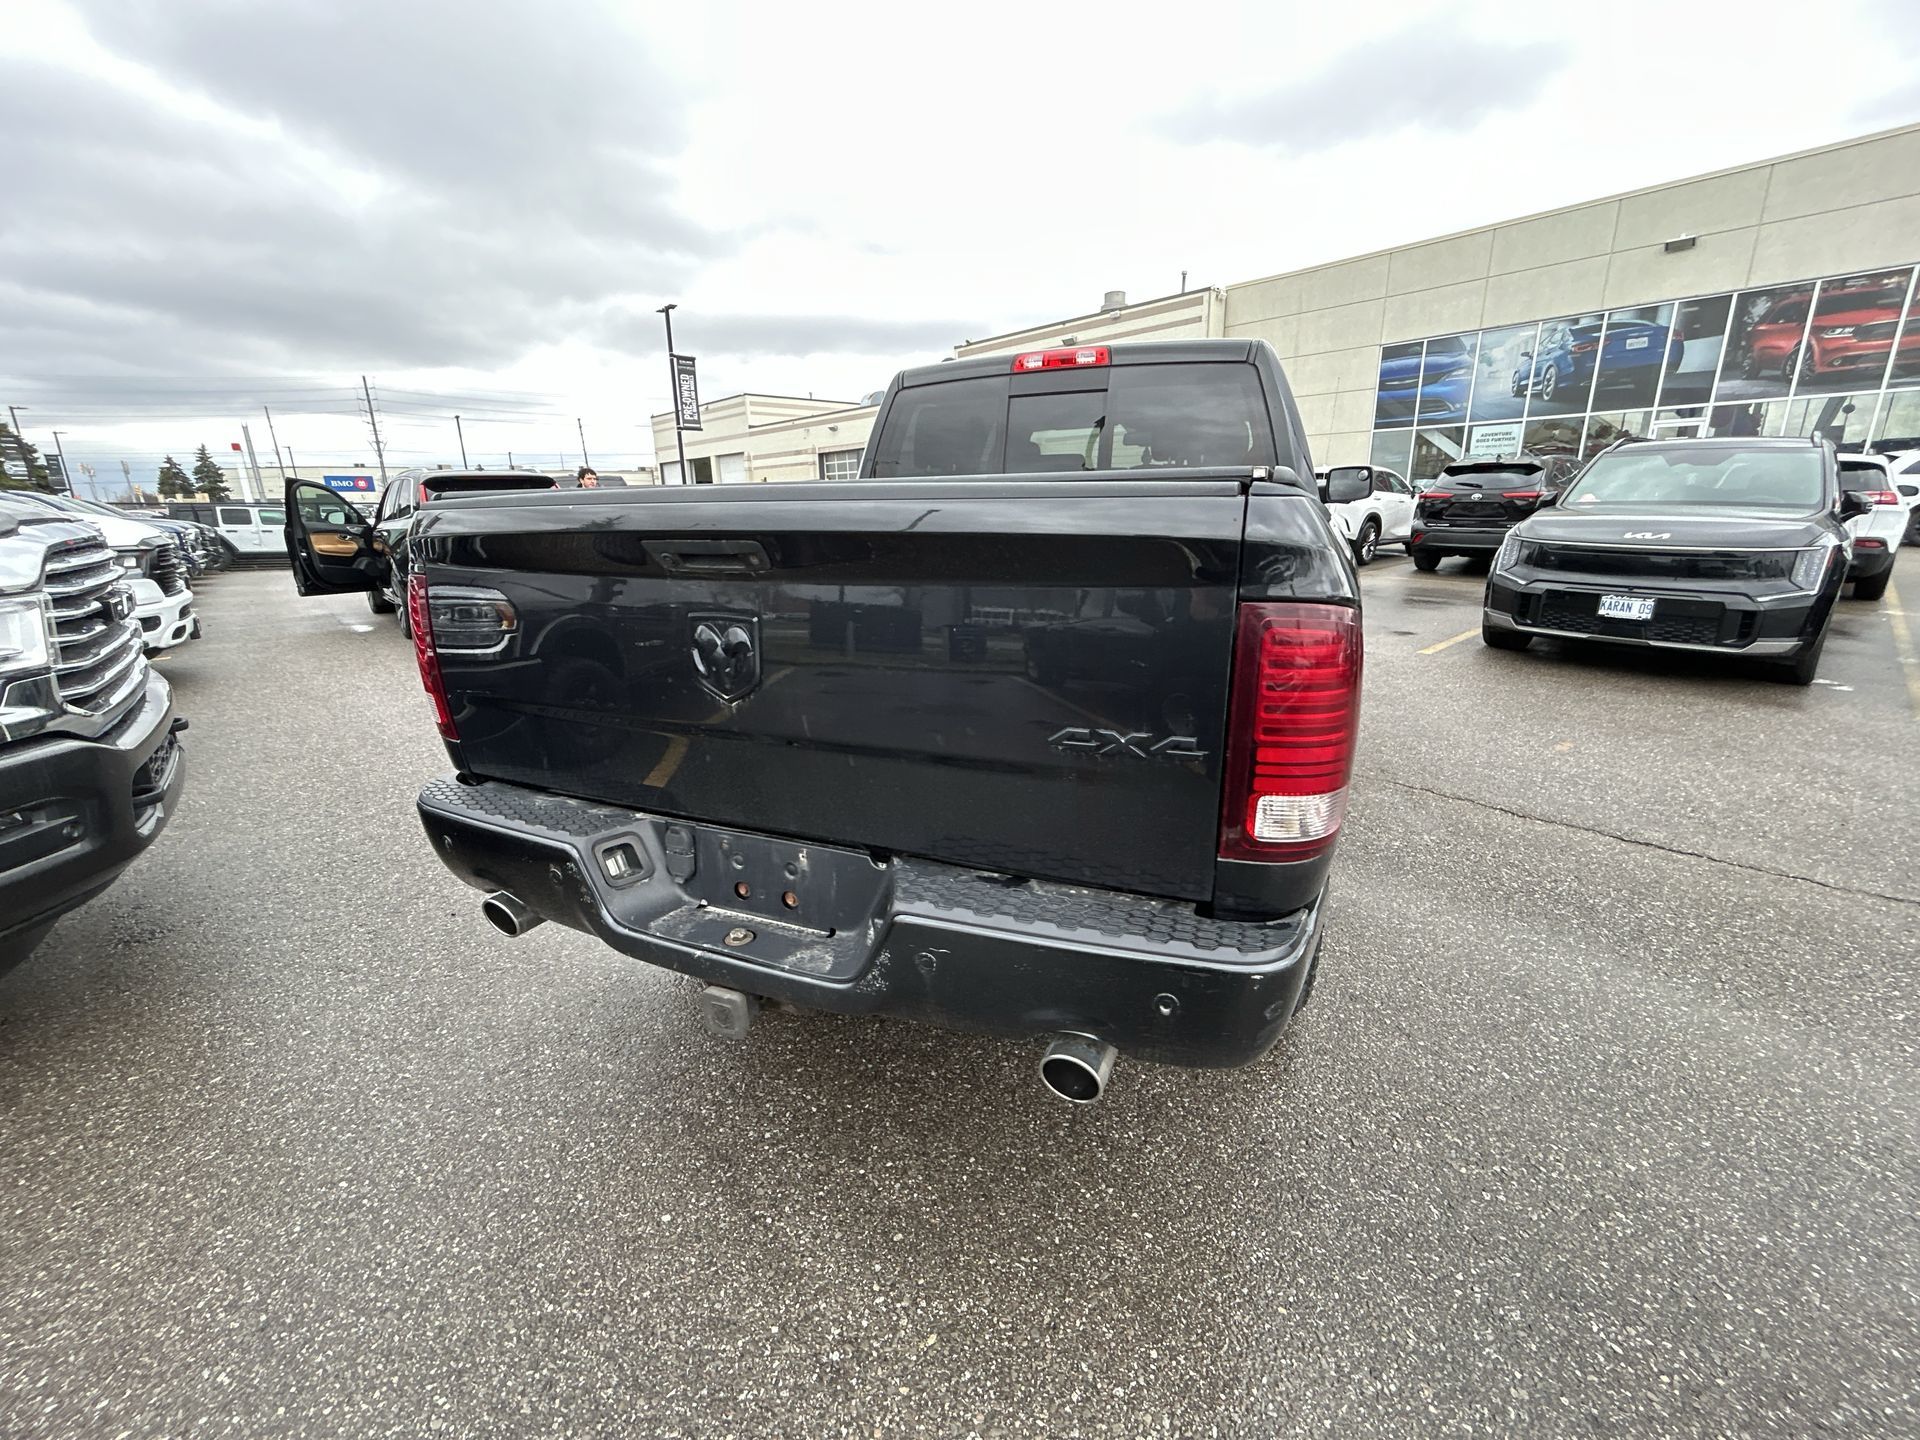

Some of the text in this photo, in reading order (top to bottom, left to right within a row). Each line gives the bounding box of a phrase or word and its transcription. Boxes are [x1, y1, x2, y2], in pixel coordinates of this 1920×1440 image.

[680, 374, 693, 420] PRE-OWNED
[1600, 600, 1652, 615] KARAN 09
